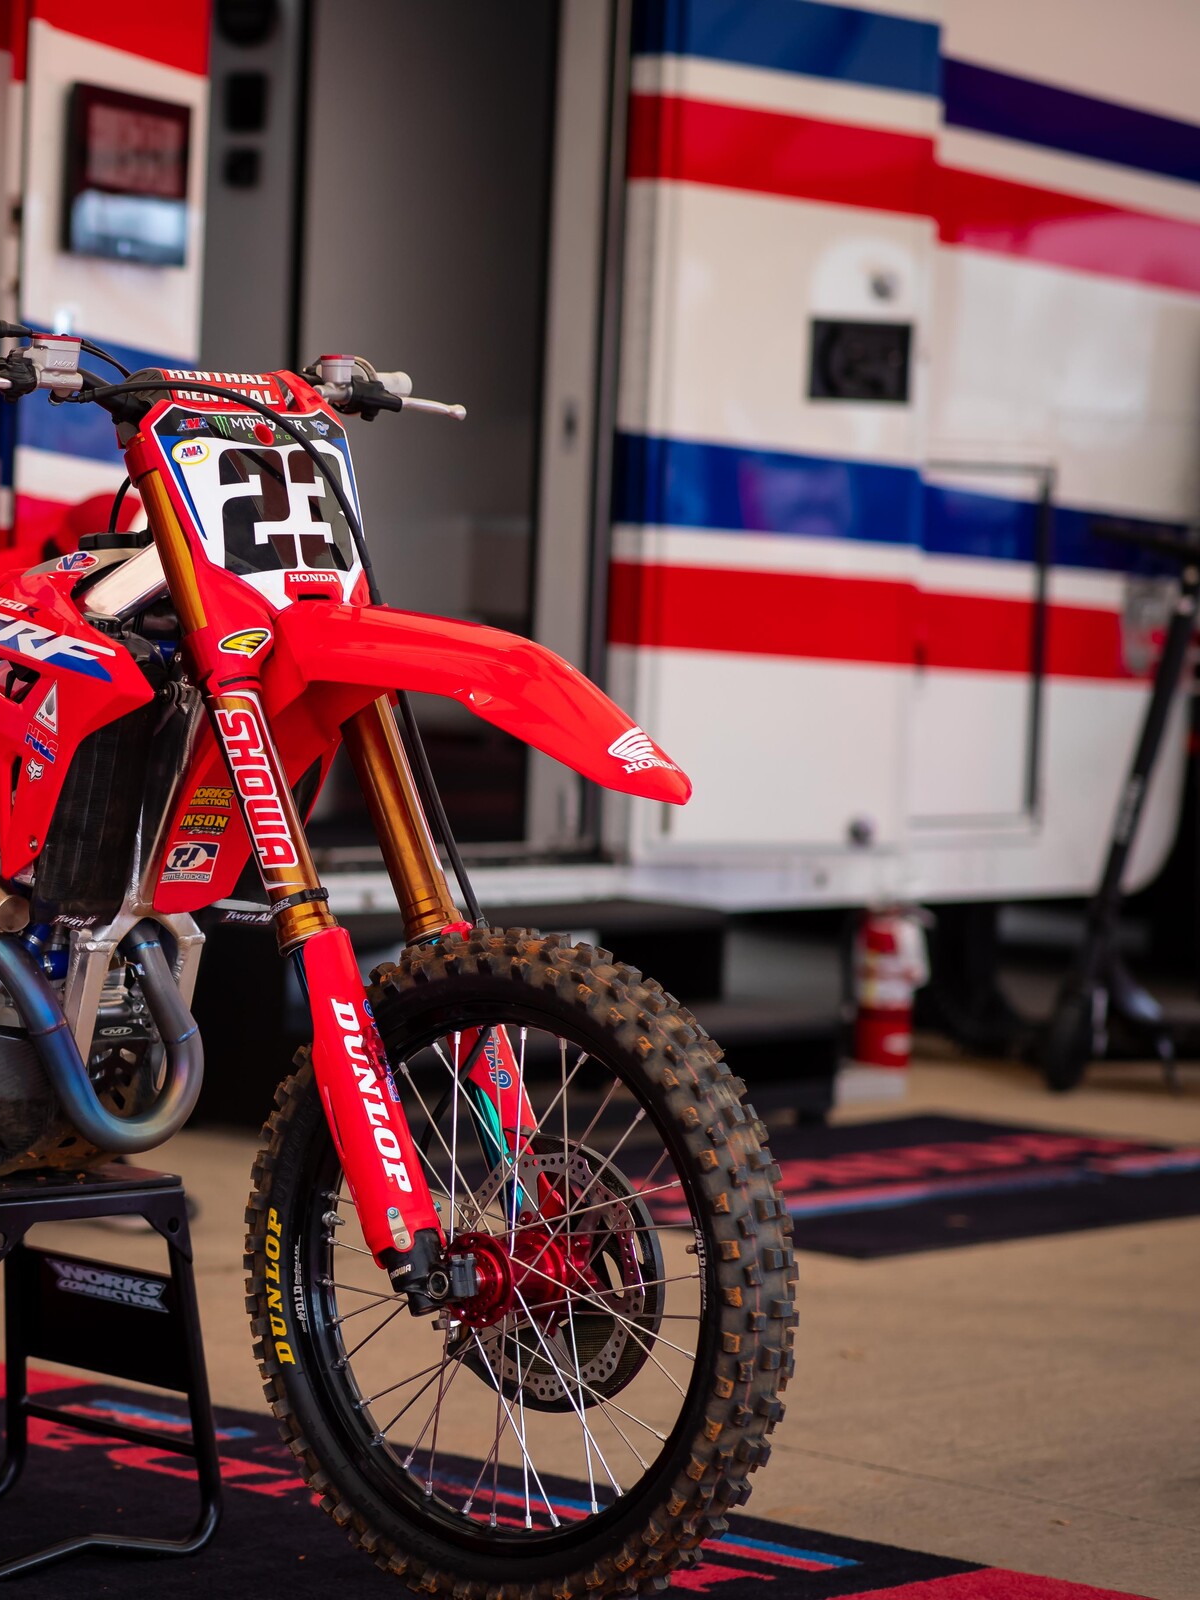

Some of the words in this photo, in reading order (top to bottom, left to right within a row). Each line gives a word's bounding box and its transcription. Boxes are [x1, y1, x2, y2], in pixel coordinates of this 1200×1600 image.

[166, 369, 271, 385] RENTHAL
[177, 417, 210, 432] AMA
[181, 445, 203, 459] AMA
[218, 448, 354, 576] 23
[62, 553, 88, 570] VP
[288, 573, 338, 583] HONDA
[25, 723, 59, 764] HRC
[621, 760, 683, 774] HONDA
[215, 708, 299, 869] SHOWA
[180, 814, 230, 828] INSON
[54, 914, 84, 927] Twin
[225, 911, 256, 921] Twin
[331, 998, 413, 1193] DUNLOP
[52, 1261, 163, 1297] WORKS
[265, 1207, 296, 1365] DUNLOP
